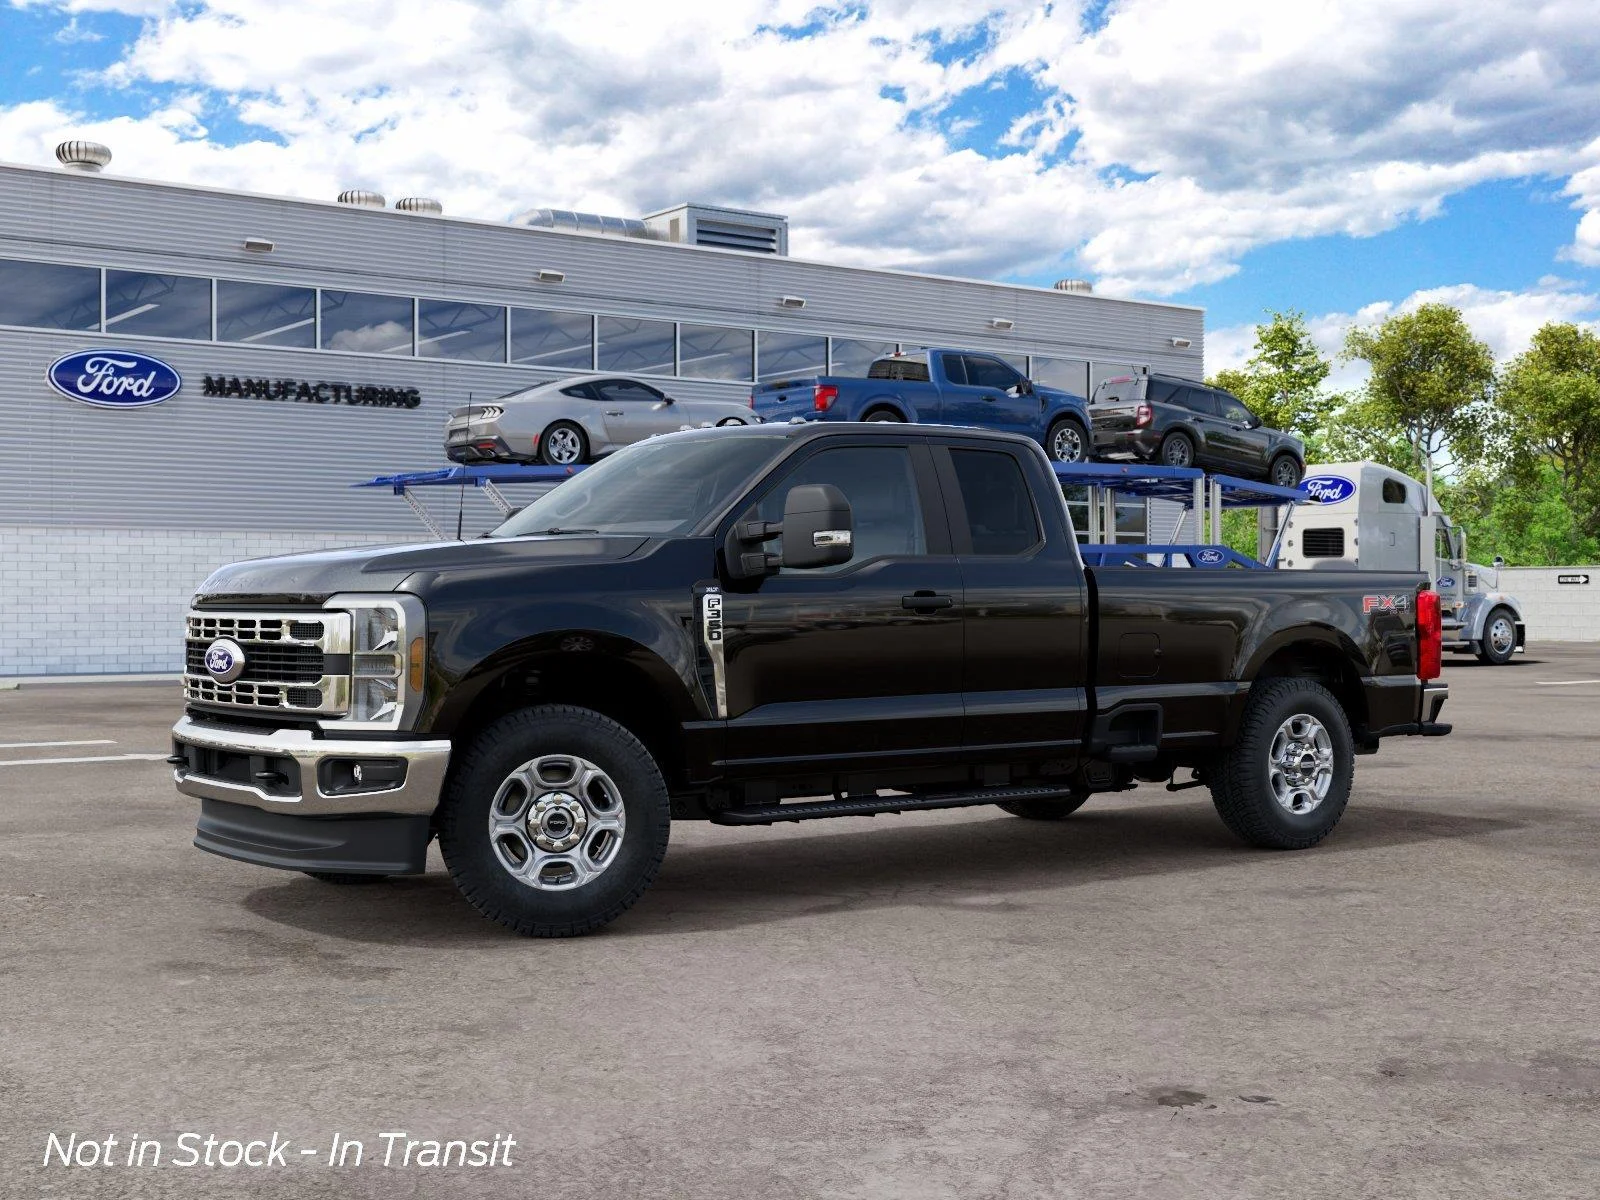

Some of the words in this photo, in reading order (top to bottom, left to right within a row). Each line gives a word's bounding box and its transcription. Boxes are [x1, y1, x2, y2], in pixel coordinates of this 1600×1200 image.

[77, 356, 157, 398] Ford
[202, 374, 421, 409] MANUFACTURING
[1201, 550, 1219, 561] Ford
[1362, 594, 1408, 615] FX4
[210, 650, 229, 670] Ford
